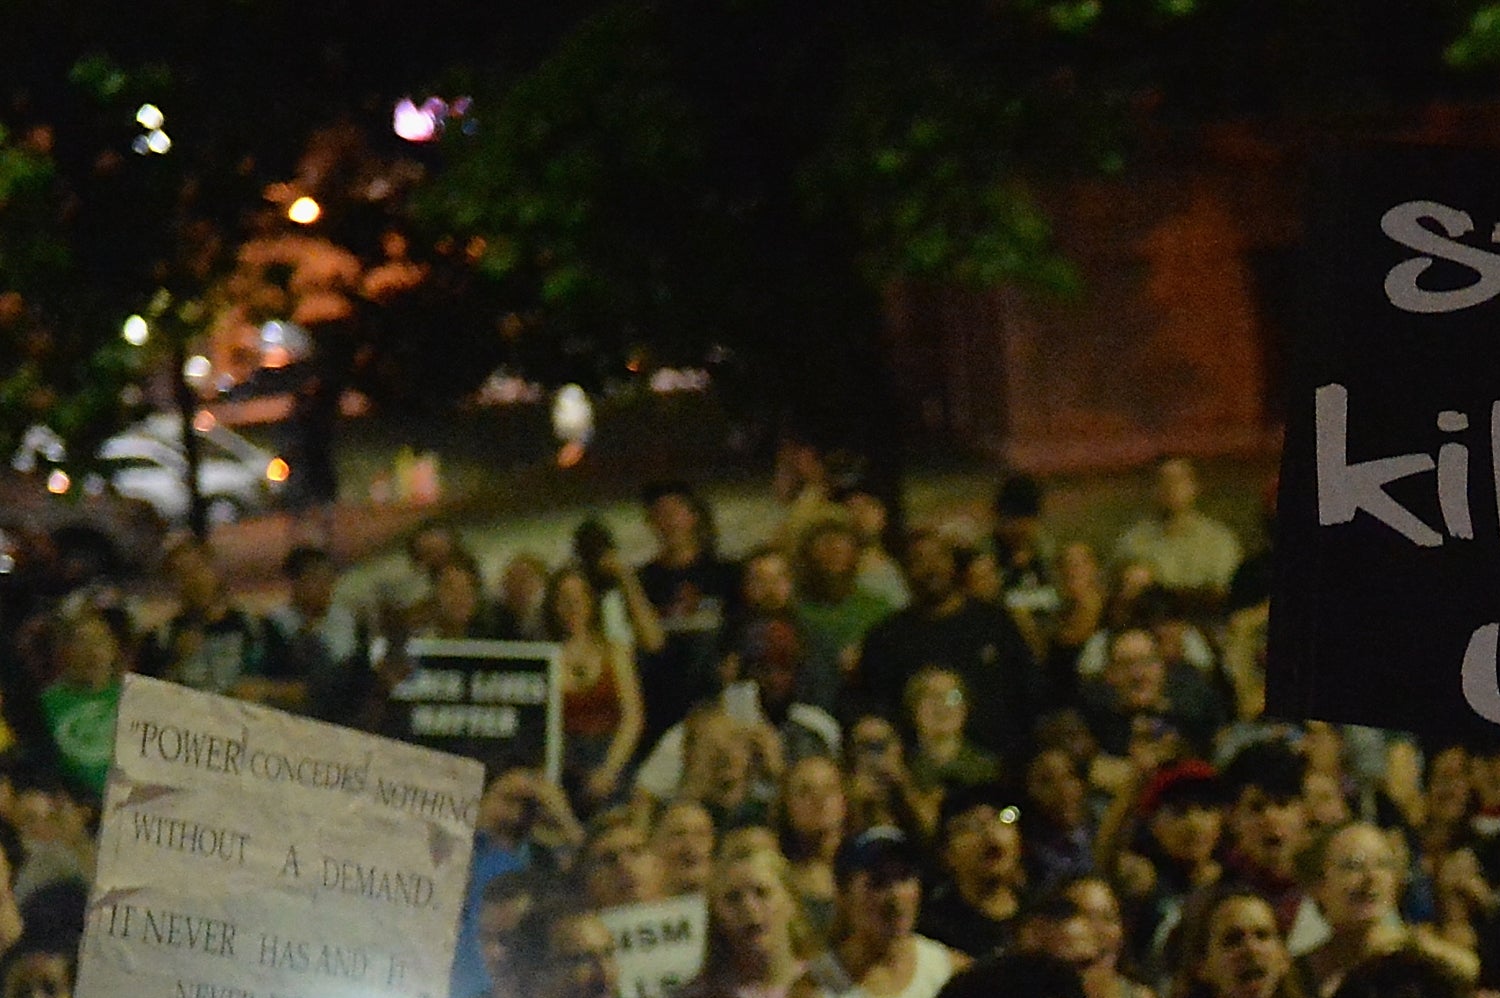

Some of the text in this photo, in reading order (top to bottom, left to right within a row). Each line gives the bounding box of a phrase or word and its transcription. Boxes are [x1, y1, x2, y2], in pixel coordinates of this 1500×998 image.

[250, 749, 366, 793] CONCEDES
[133, 811, 250, 867] WITHOUT
[280, 844, 301, 879] A
[106, 902, 136, 938] IT
[143, 908, 237, 957] NEVER
[259, 933, 311, 972] HAS
[316, 944, 369, 982] AND
